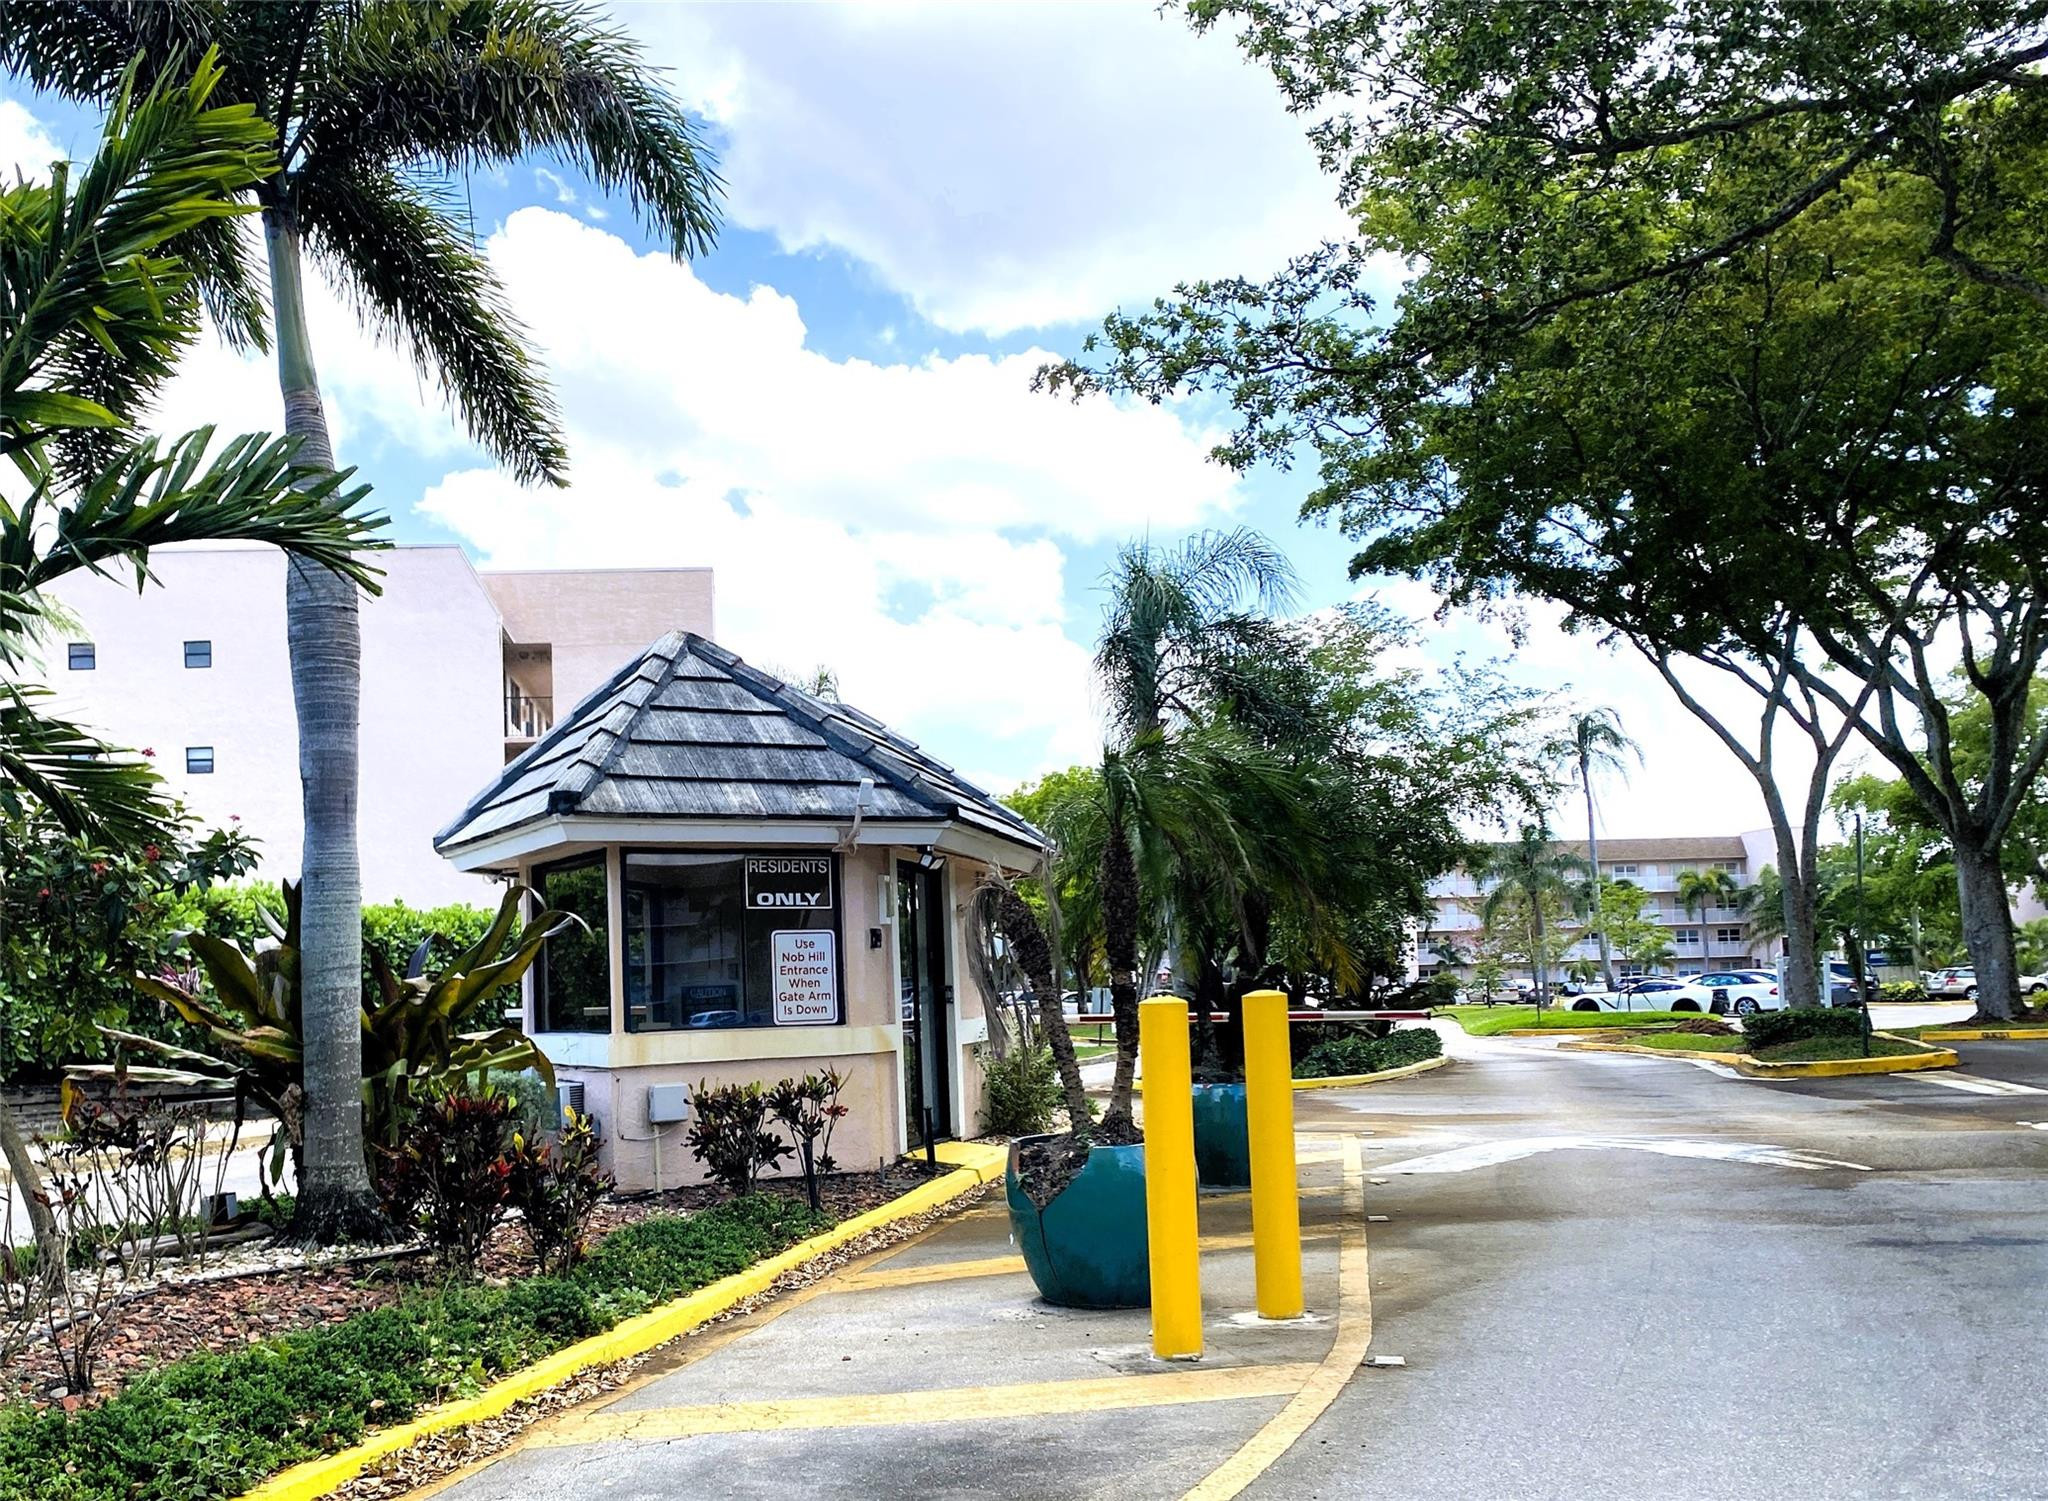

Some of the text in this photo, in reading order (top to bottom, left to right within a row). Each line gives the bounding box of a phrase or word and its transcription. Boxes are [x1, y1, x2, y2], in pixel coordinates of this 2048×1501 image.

[749, 860, 828, 874] RESIDENTS
[756, 892, 821, 906] ONLY
[795, 939, 815, 949] Use
[782, 952, 825, 962] Nob Hill
[780, 966, 828, 975] Entrance
[789, 979, 820, 988] When
[779, 992, 831, 1002] Gate Arm
[784, 1005, 827, 1015] Is Down
